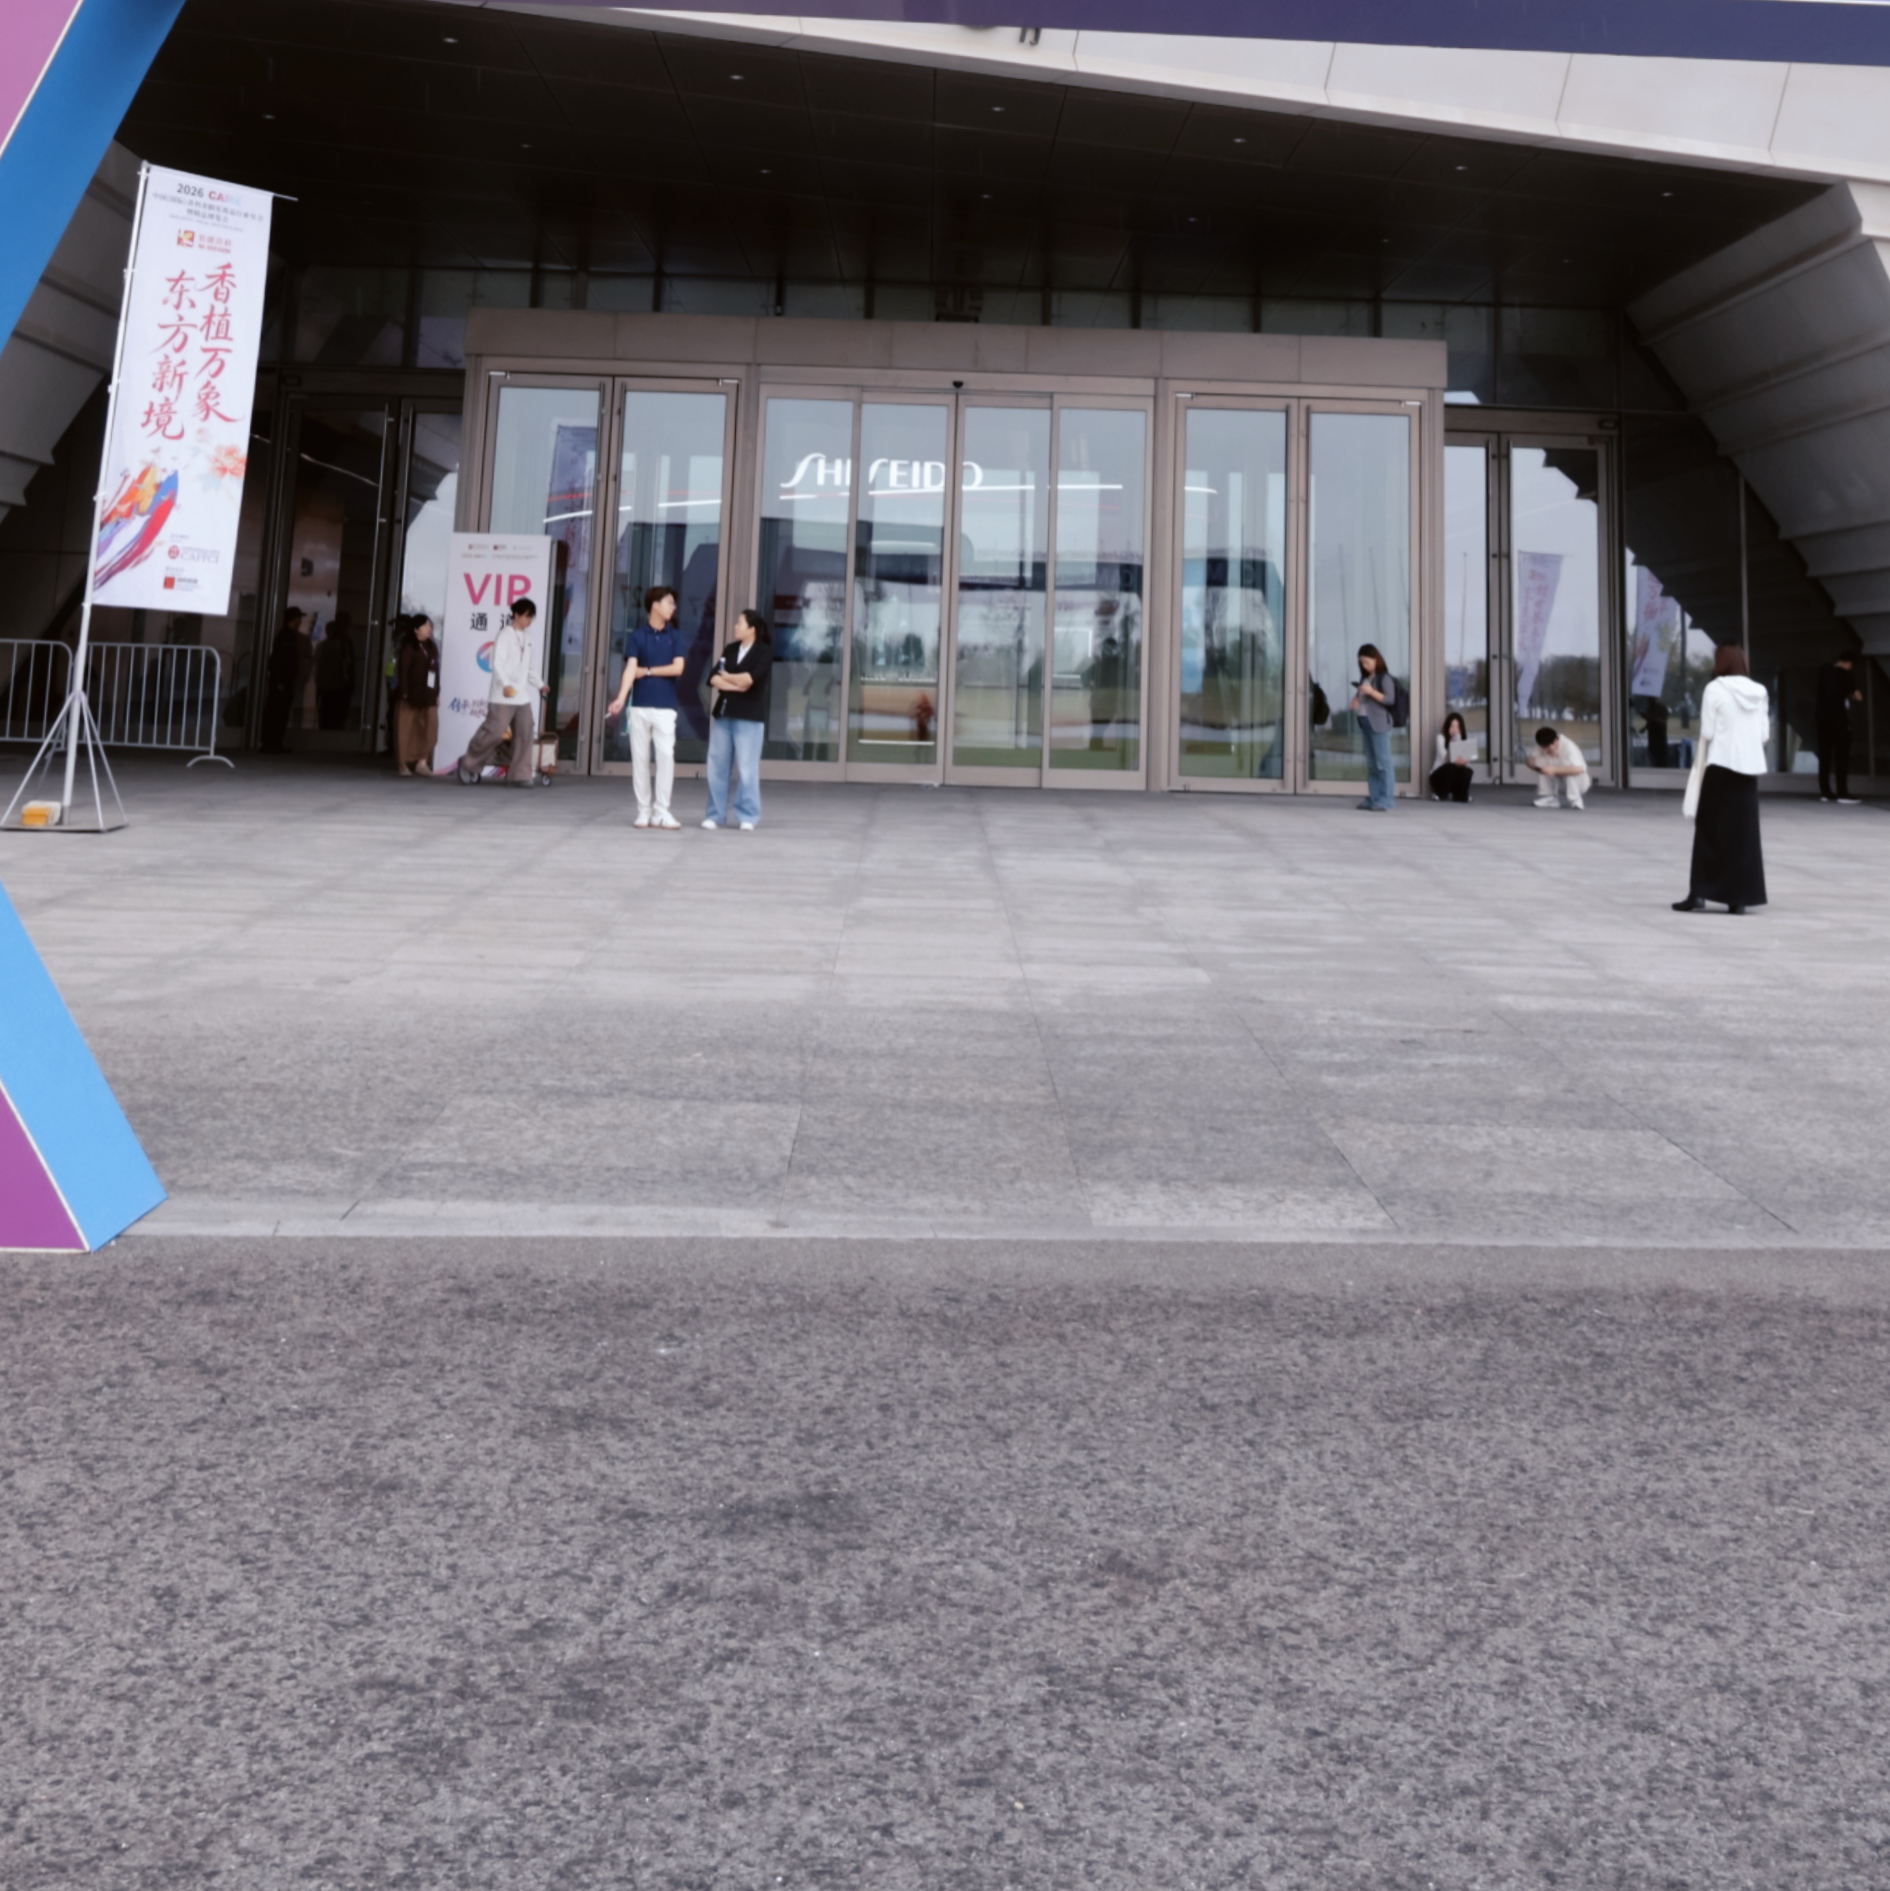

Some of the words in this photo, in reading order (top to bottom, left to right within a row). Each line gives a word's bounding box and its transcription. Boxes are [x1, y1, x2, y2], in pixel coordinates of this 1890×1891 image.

[140, 269, 198, 441] 东方新境
[192, 262, 245, 423] 香植万象
[463, 572, 532, 607] VIP
